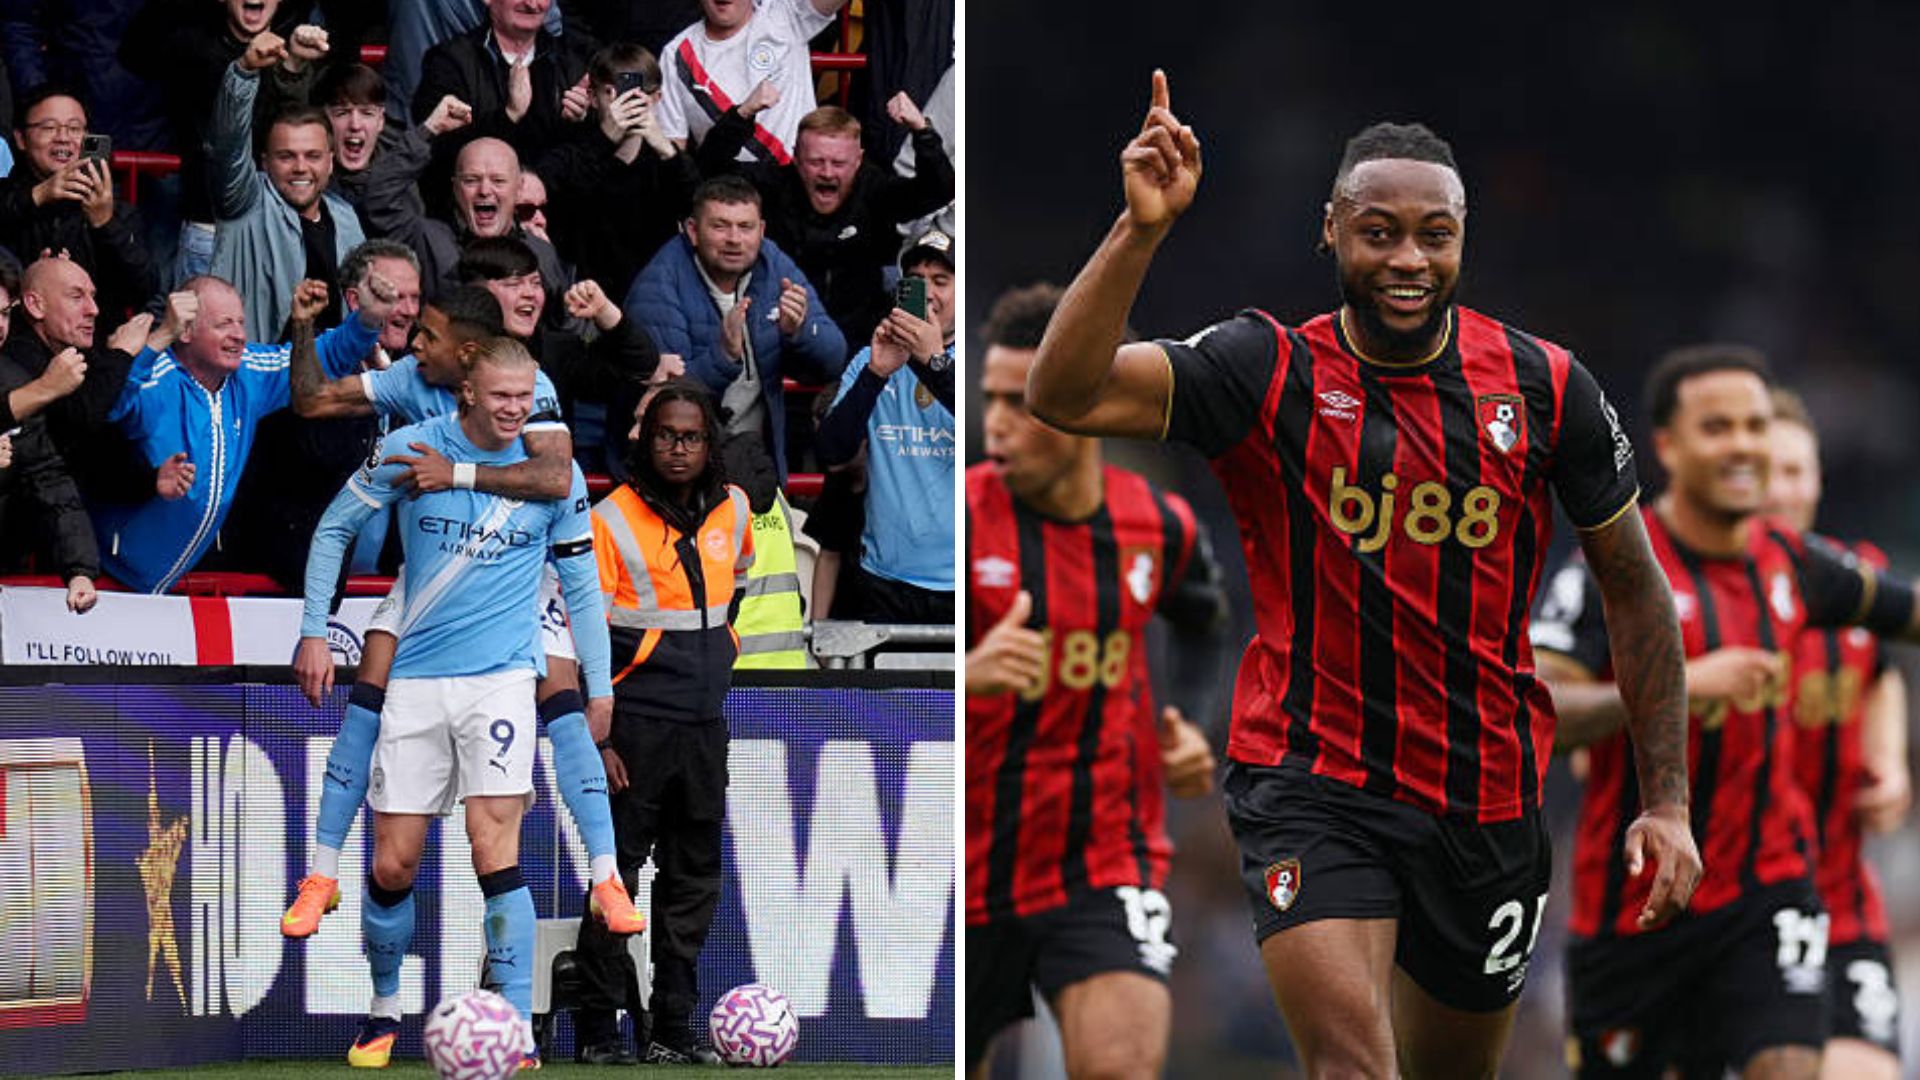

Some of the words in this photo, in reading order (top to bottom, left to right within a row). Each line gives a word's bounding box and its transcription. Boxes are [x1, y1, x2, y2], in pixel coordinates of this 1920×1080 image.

[876, 424, 955, 442] ETIHA
[1330, 466, 1500, 553] bj88
[418, 515, 531, 547] ETIHAD
[438, 541, 503, 561] AIRWAYS
[27, 642, 58, 660] I'LL
[64, 644, 132, 666] FOLLOW
[137, 650, 170, 666] YOU
[1019, 627, 1131, 700] j88
[489, 719, 515, 758] 9
